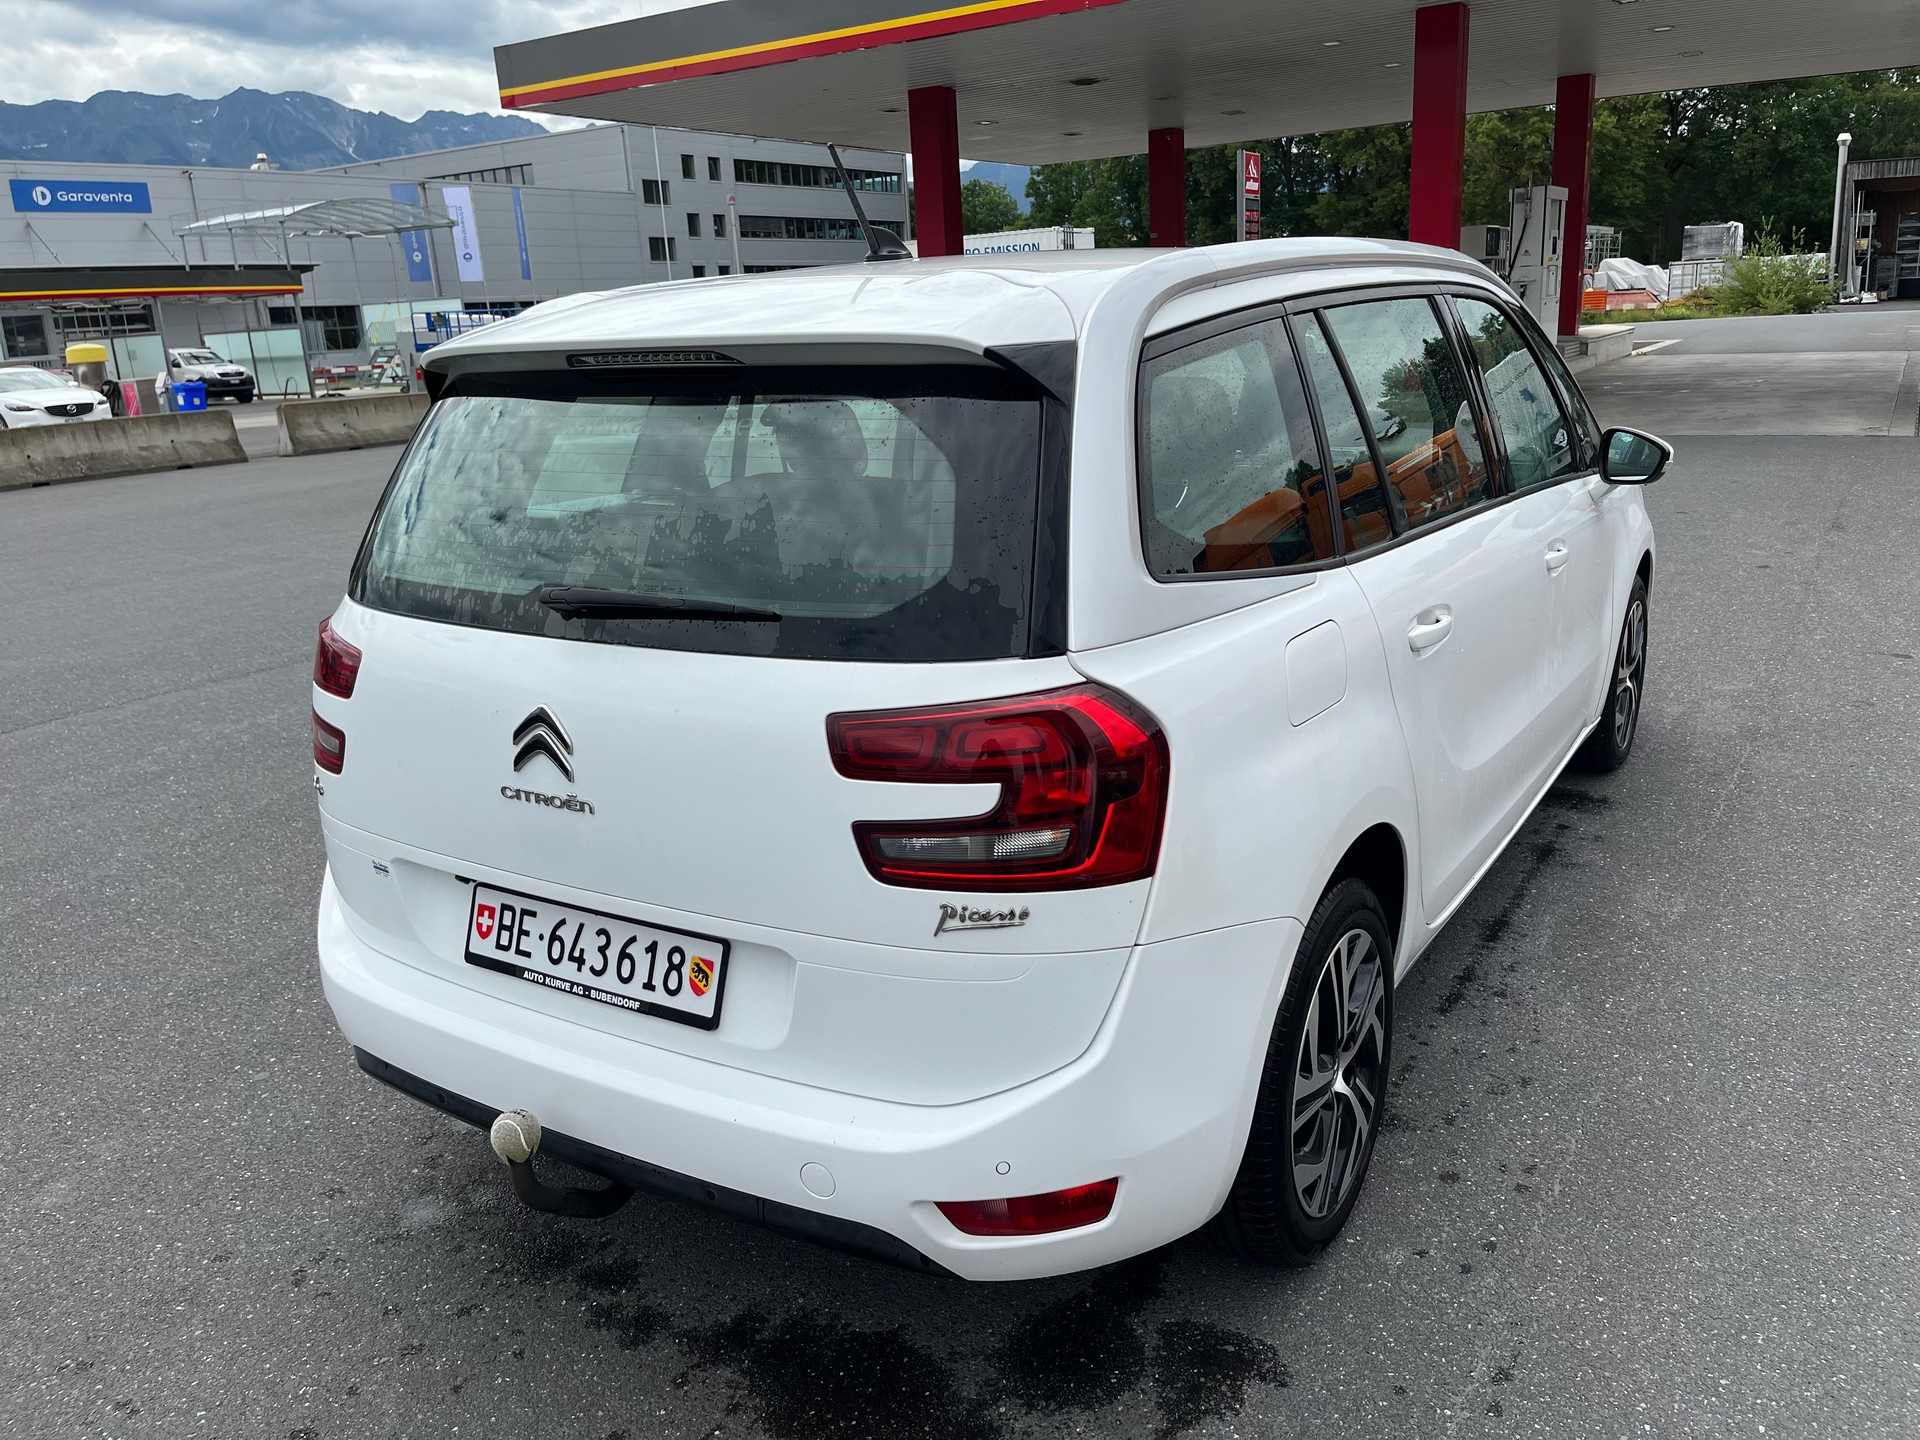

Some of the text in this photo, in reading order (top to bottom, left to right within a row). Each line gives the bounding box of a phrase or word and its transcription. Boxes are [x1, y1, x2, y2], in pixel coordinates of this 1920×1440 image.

[57, 191, 133, 203] Garaventa
[984, 242, 1040, 254] EMISSION
[934, 901, 1030, 937] Picasso
[523, 970, 544, 983] AUTO
[545, 976, 571, 992] KURVE
[572, 984, 584, 995] AG
[590, 989, 641, 1011] BUBENDORF
